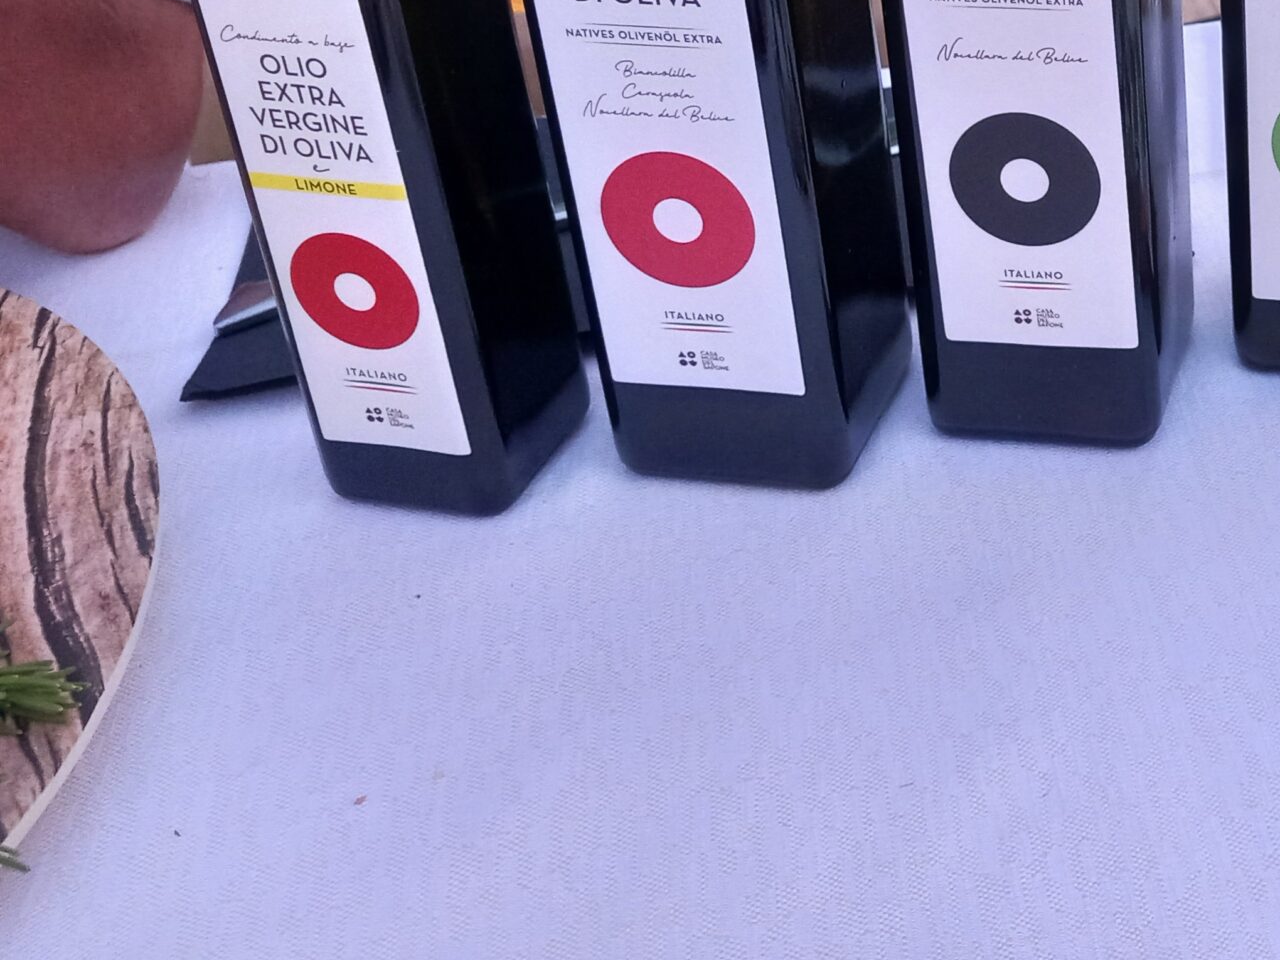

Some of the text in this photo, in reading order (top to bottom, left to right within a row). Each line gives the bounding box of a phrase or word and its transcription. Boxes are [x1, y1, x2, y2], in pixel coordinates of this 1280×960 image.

[565, 28, 723, 44] NATIVES OLIVENÖL EXTRA
[1011, 50, 1034, 61] del
[259, 53, 327, 79] OLIO
[257, 80, 346, 108] EXTRA
[249, 106, 368, 136] VERGINE
[658, 109, 681, 119] del
[259, 134, 374, 163] DI OLIVA
[294, 178, 357, 196] LIMONE
[1004, 269, 1063, 280] ITALIANO
[664, 310, 725, 322] ITALIANO
[346, 367, 408, 382] ITALIANO
